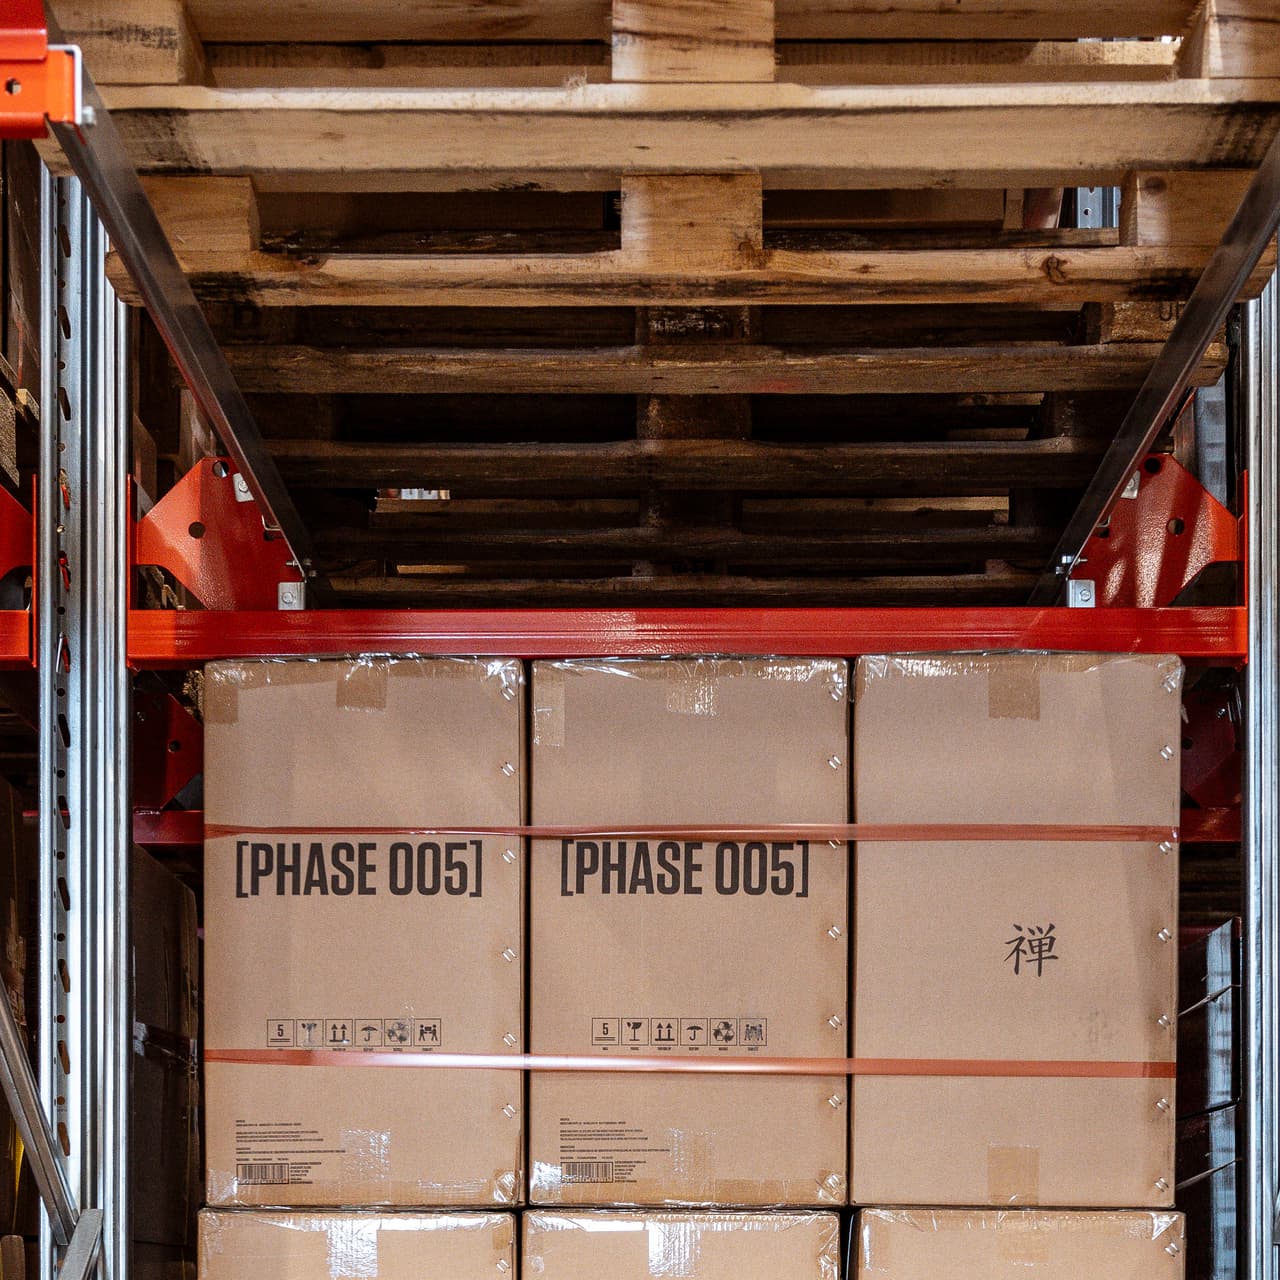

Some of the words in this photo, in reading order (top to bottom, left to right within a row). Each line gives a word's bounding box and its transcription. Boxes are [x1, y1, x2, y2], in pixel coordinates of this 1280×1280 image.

[235, 838, 378, 897] [PHASE
[389, 838, 483, 898] 005]
[560, 838, 703, 897] [PHASE
[713, 838, 809, 898] 005]
[1003, 923, 1059, 978] 禅
[277, 1023, 284, 1038] 5
[602, 1022, 609, 1036] 5
